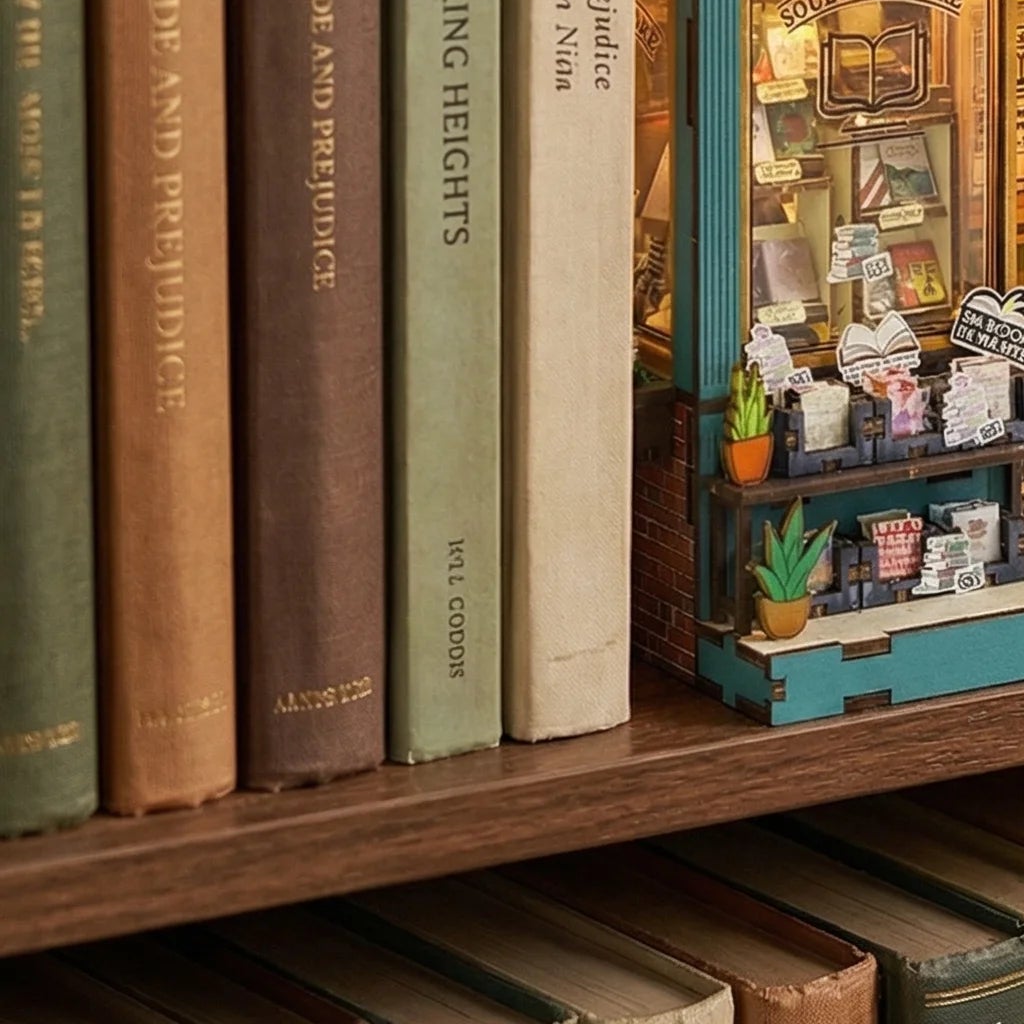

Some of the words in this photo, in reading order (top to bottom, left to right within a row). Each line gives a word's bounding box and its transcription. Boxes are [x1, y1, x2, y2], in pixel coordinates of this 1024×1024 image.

[150, 66, 182, 160] AND
[311, 42, 335, 111] AND
[305, 118, 337, 291] PREJUDICE
[442, 83, 470, 247] HEIGHTS
[145, 171, 187, 414] PREJUDICE
